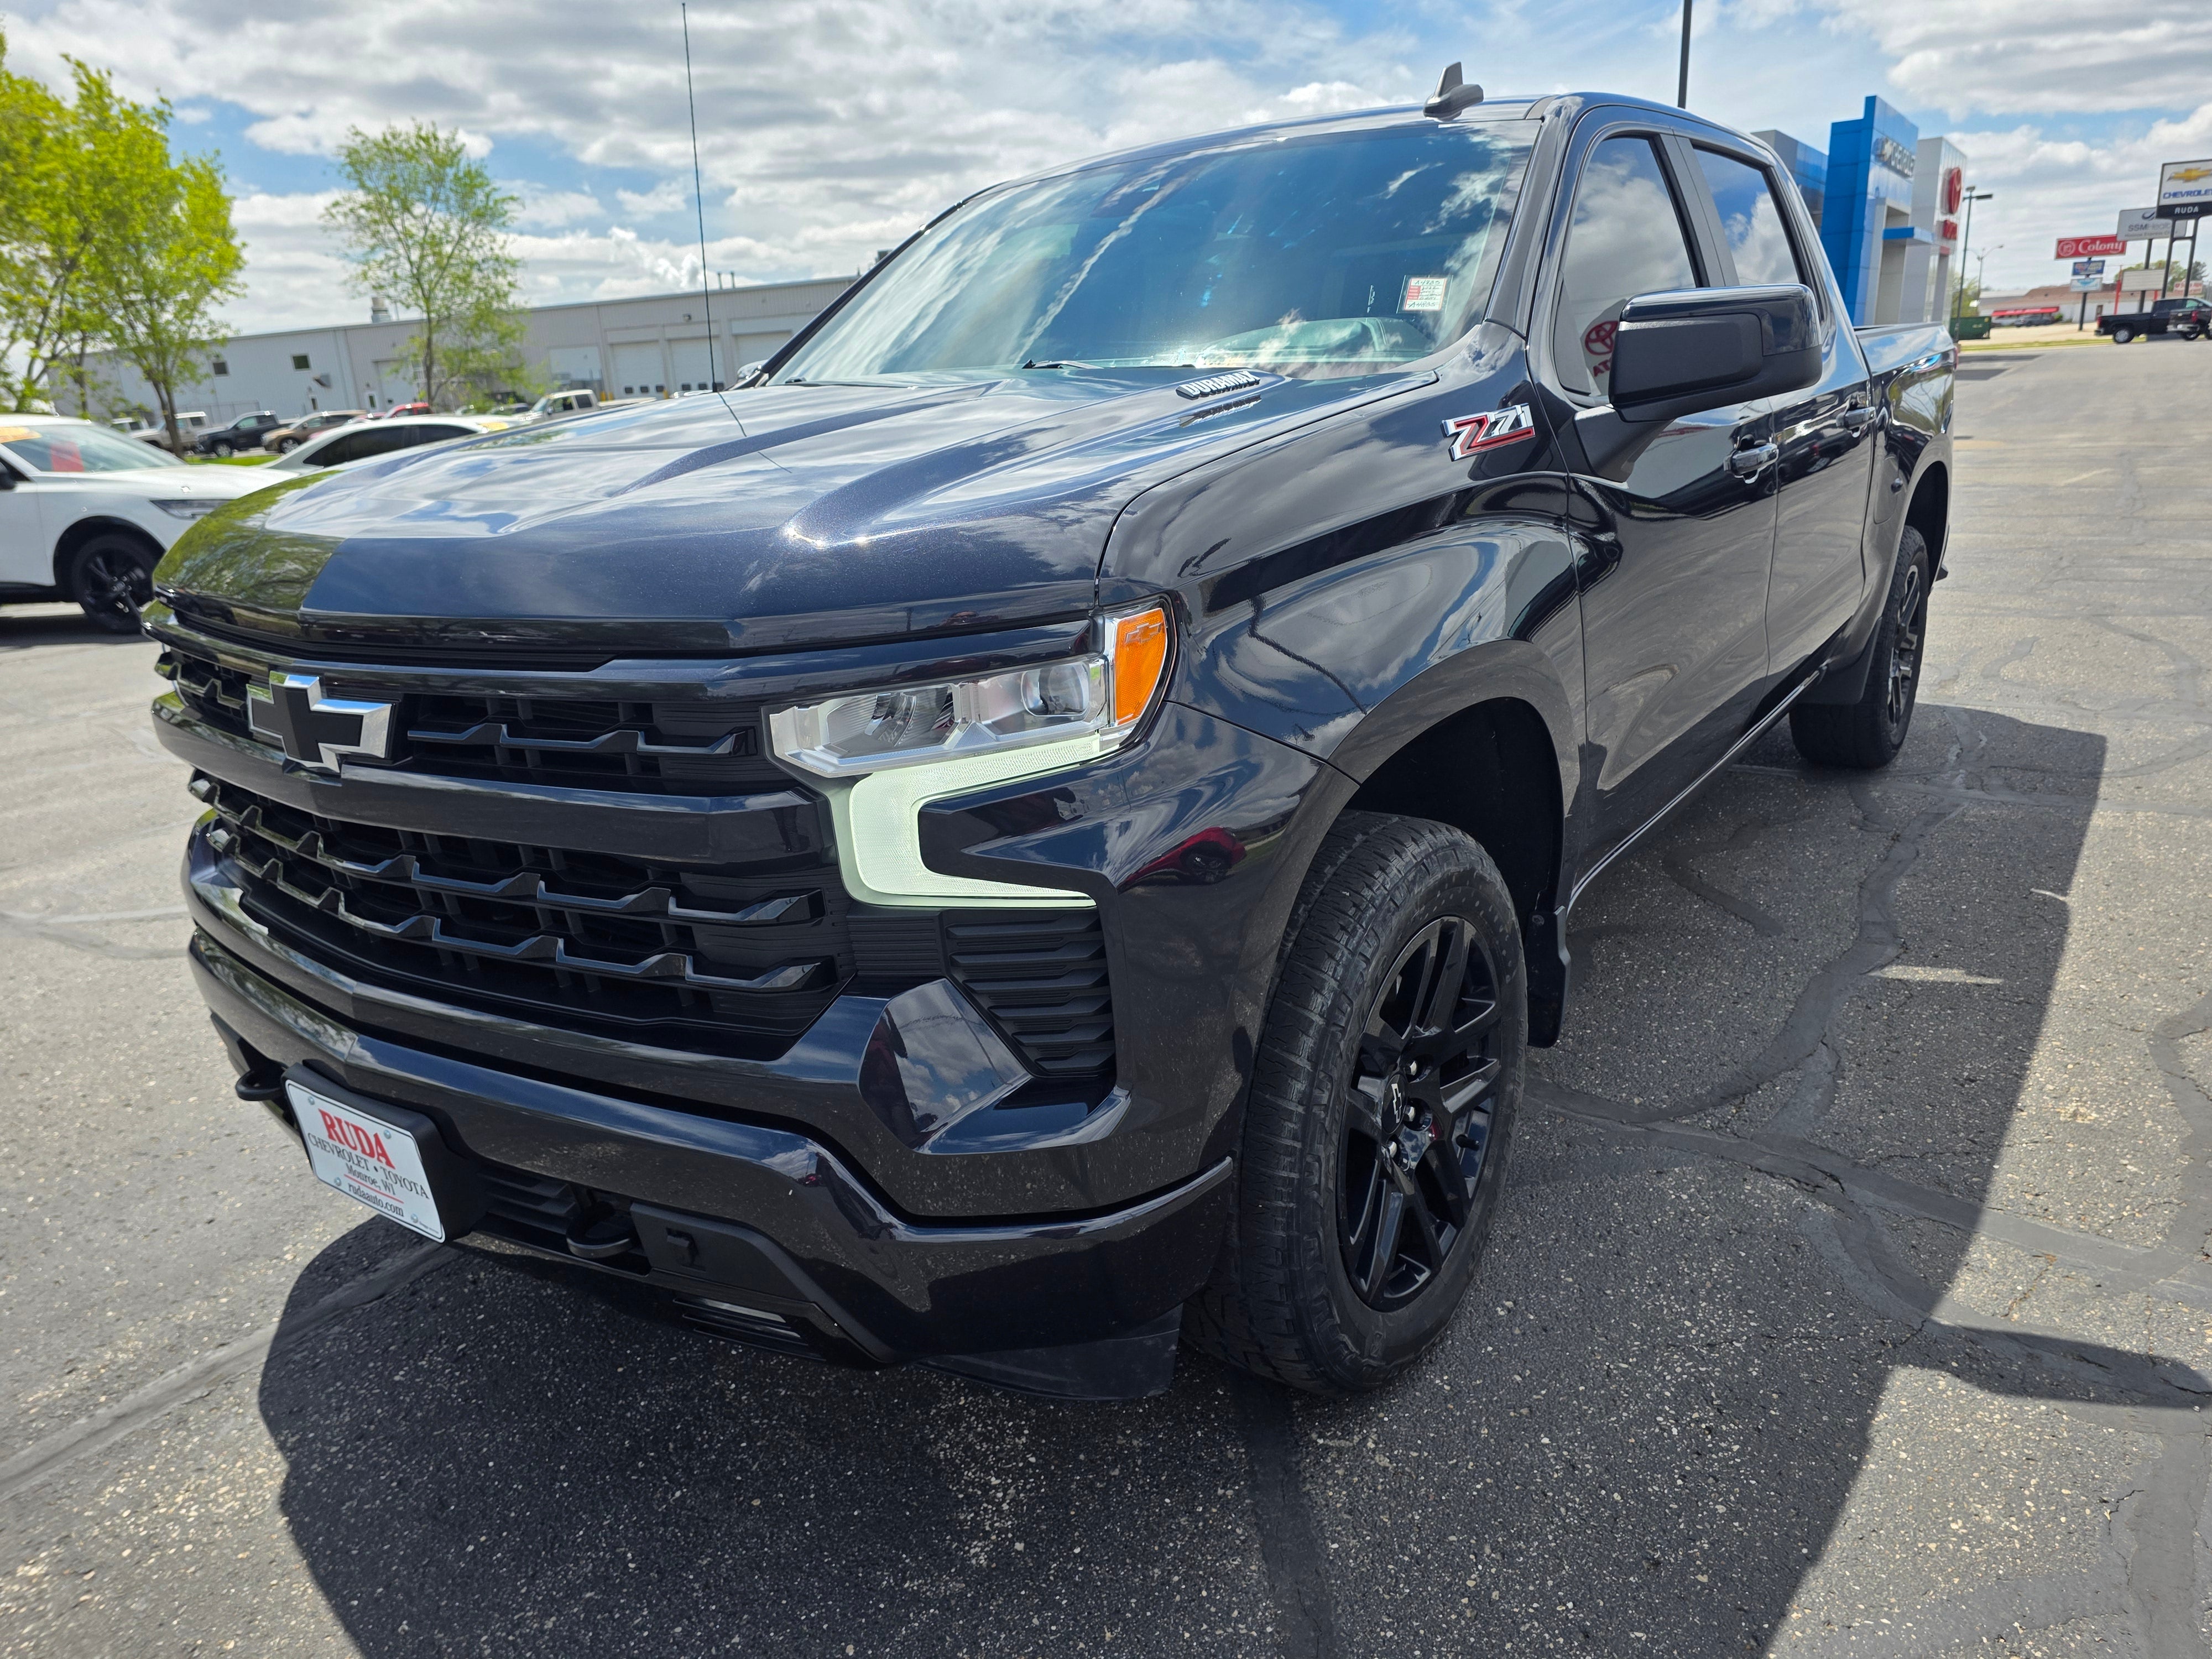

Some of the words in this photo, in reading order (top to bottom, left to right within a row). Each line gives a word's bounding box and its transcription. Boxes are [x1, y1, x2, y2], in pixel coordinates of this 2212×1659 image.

[2163, 189, 2212, 200] CHEVROLE
[2174, 205, 2199, 215] RUDA
[2078, 239, 2122, 254] Colony
[1176, 370, 1261, 400] DURAMAX
[1441, 403, 1536, 461] Z71
[318, 1108, 396, 1170] RUDA
[307, 1132, 371, 1172] CHEVROLET
[380, 1166, 430, 1199] TOYOTA
[345, 1162, 382, 1191] Monroe,
[380, 1178, 396, 1196] WI
[348, 1182, 405, 1218] rudaauto.com
